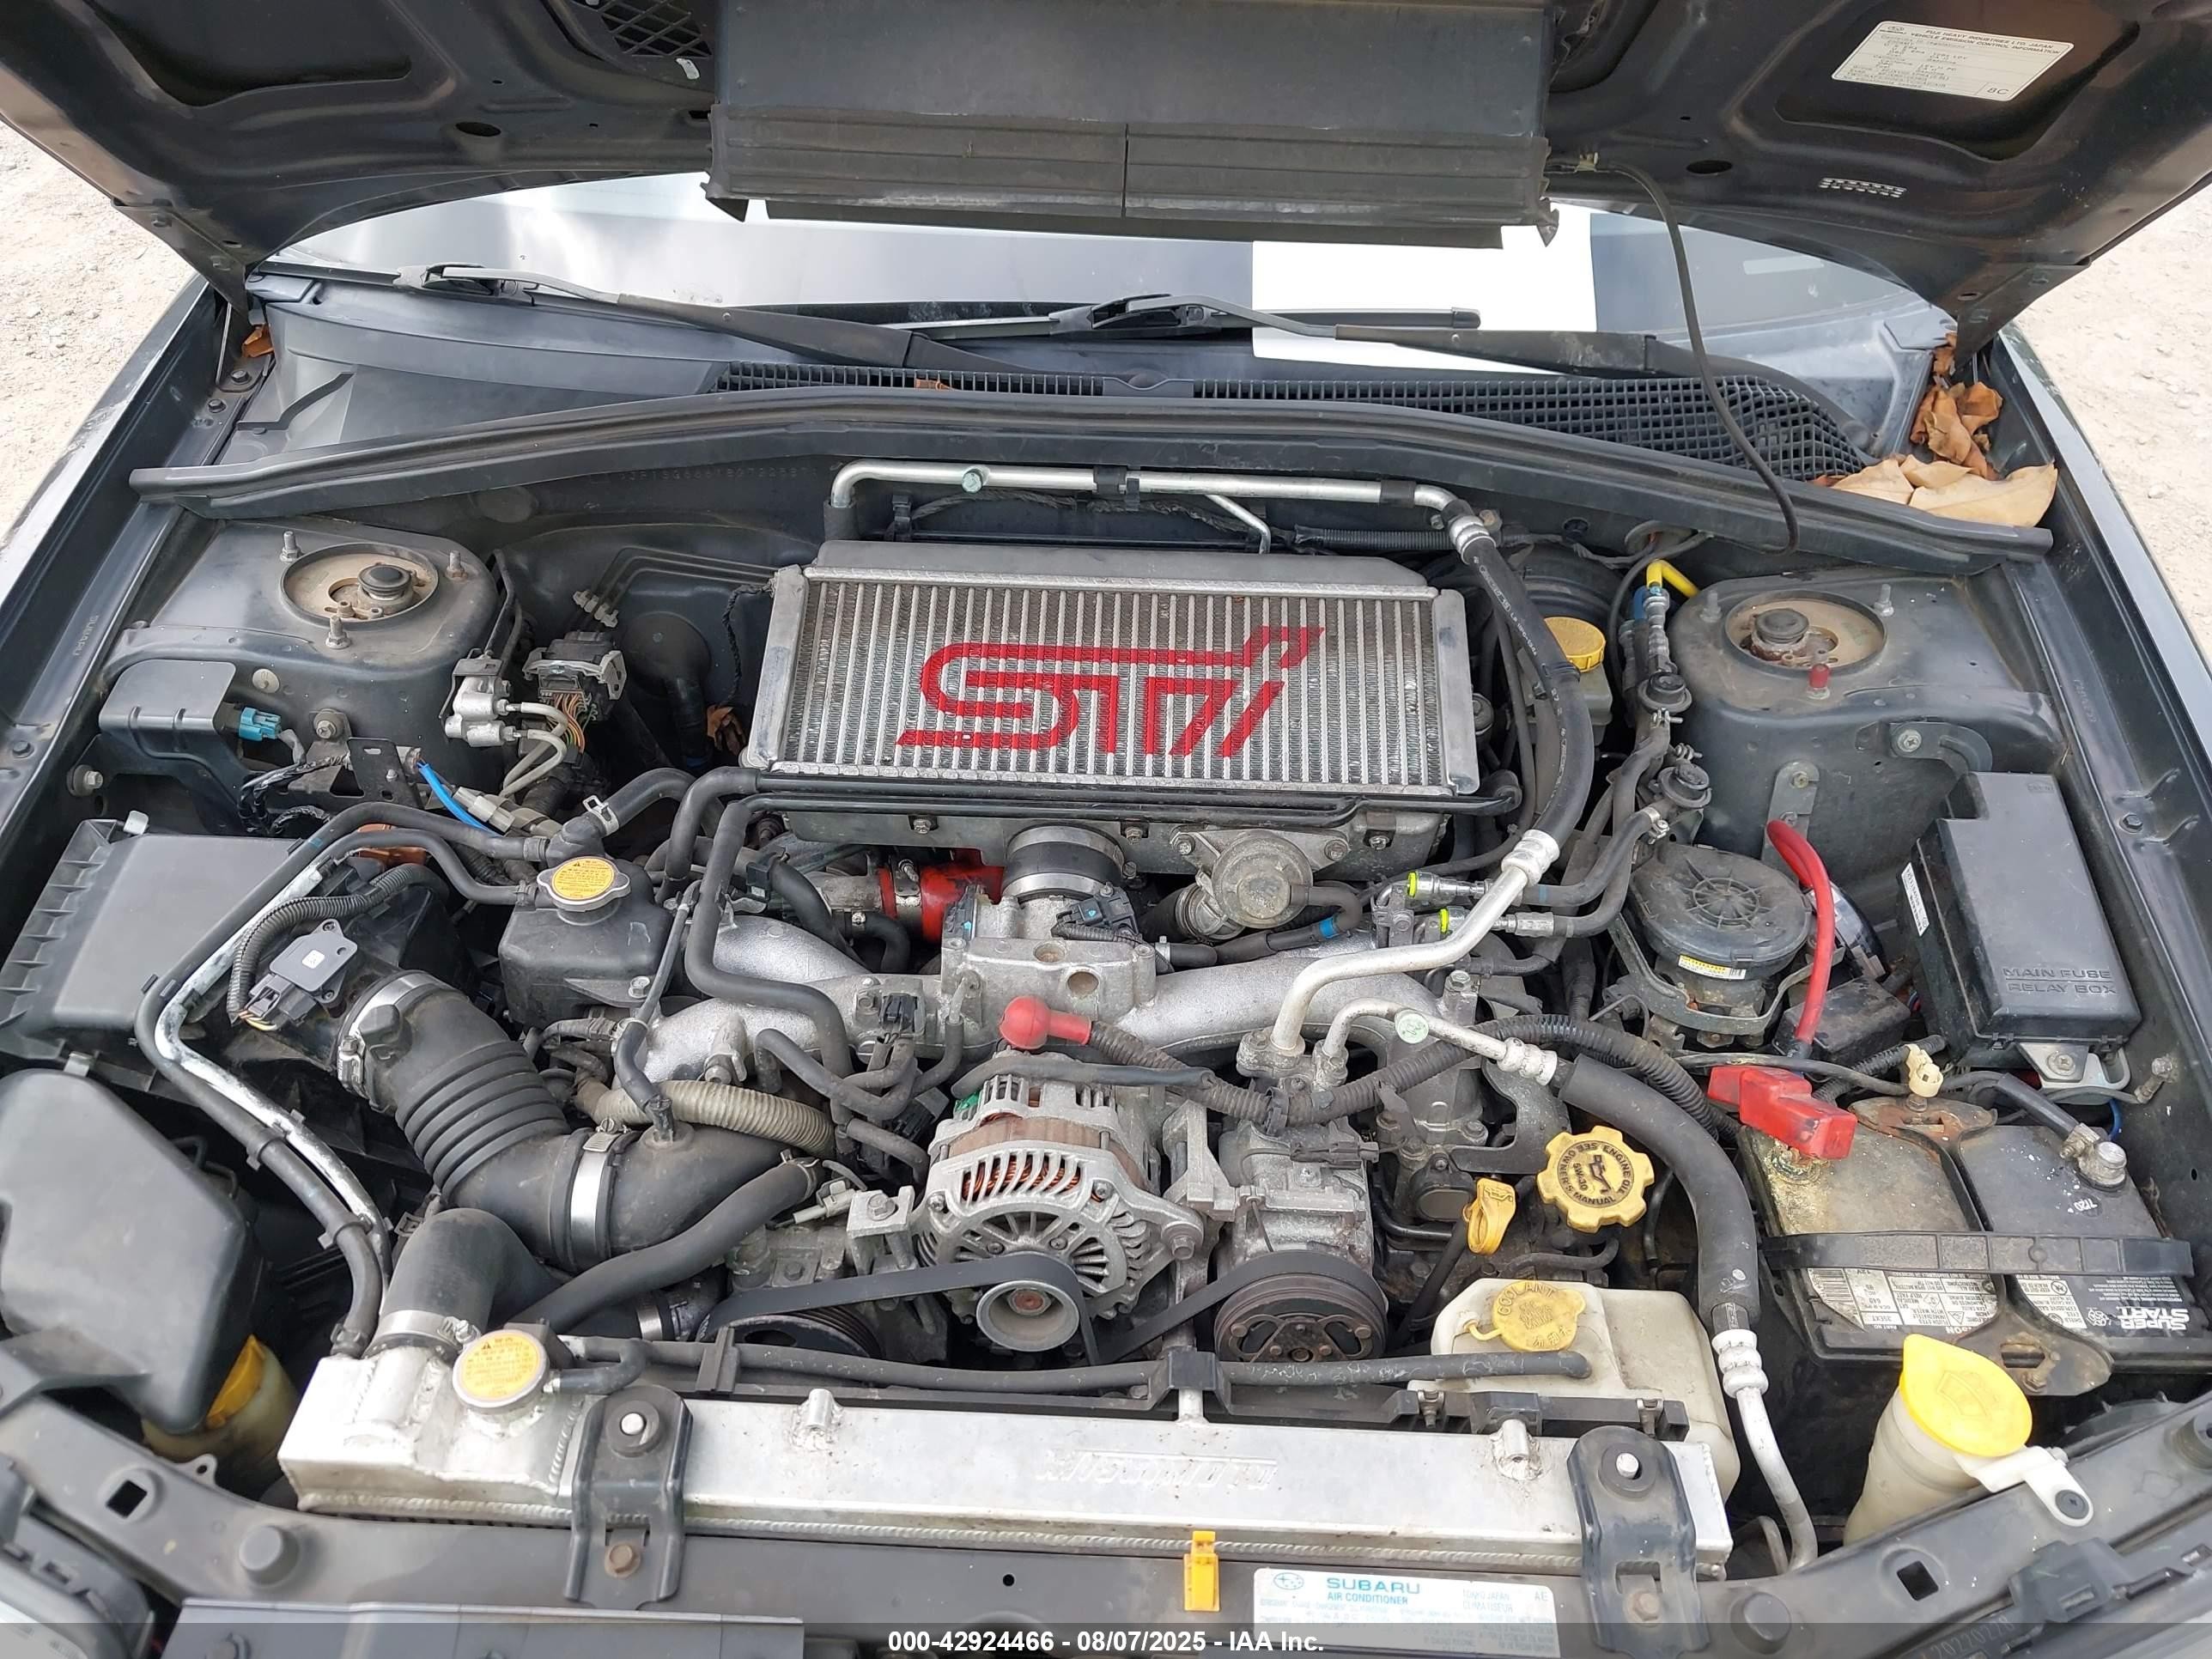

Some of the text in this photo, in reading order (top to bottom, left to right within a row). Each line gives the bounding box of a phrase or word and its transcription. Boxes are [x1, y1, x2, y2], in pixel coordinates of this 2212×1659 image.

[2012, 46, 2061, 54] INFORMATION
[2002, 968, 2112, 979] MAIN FUSE
[2007, 982, 2117, 994] RELAY BOX
[1576, 1142, 1598, 1152] SEE
[1602, 1145, 1632, 1194] ENGINE OIL
[1573, 1191, 1616, 1205] MANUAL
[1497, 1280, 1557, 1316] COOLANT
[2117, 1307, 2190, 1322] START
[2119, 1318, 2186, 1331] SUPER
[1326, 1577, 1421, 1595] SUBARU
[1327, 1591, 1408, 1605] AIR CONDITIONER
